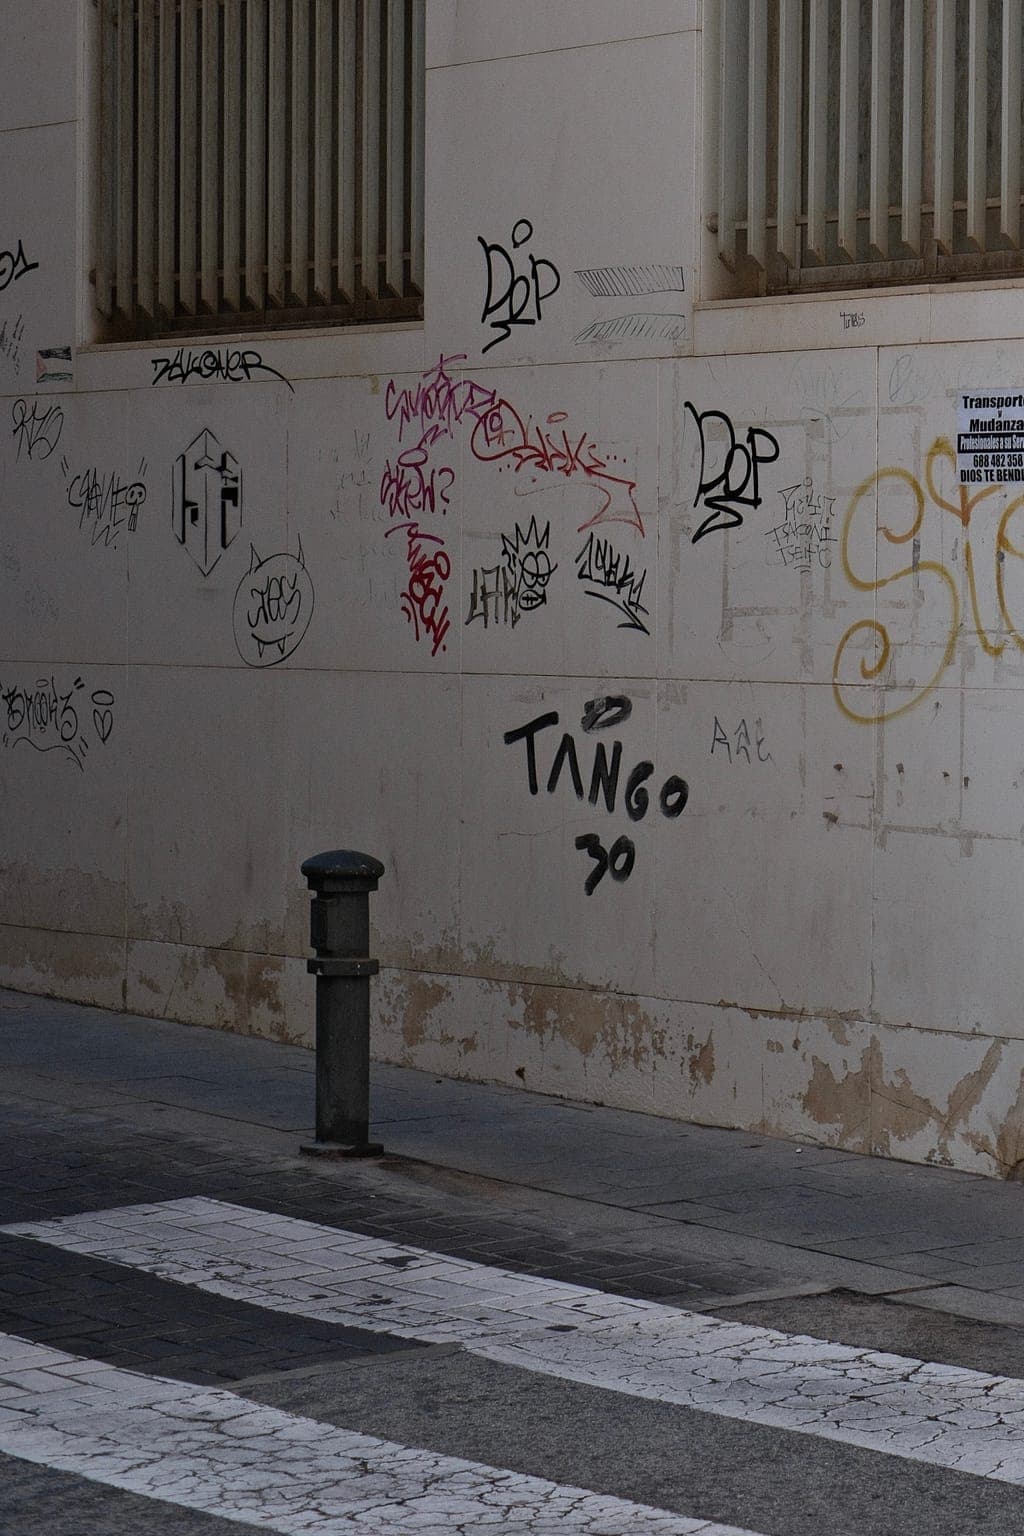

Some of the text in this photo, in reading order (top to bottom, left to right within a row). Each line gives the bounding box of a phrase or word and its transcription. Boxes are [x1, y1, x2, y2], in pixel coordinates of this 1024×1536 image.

[960, 435, 999, 450] Profesionales
[1000, 439, 1004, 449] a
[1004, 439, 1012, 449] su
[973, 454, 990, 468] 688
[1007, 454, 1024, 467] 358
[960, 469, 982, 483] DIOS
[984, 469, 994, 482] TE
[503, 710, 691, 822] TANGO
